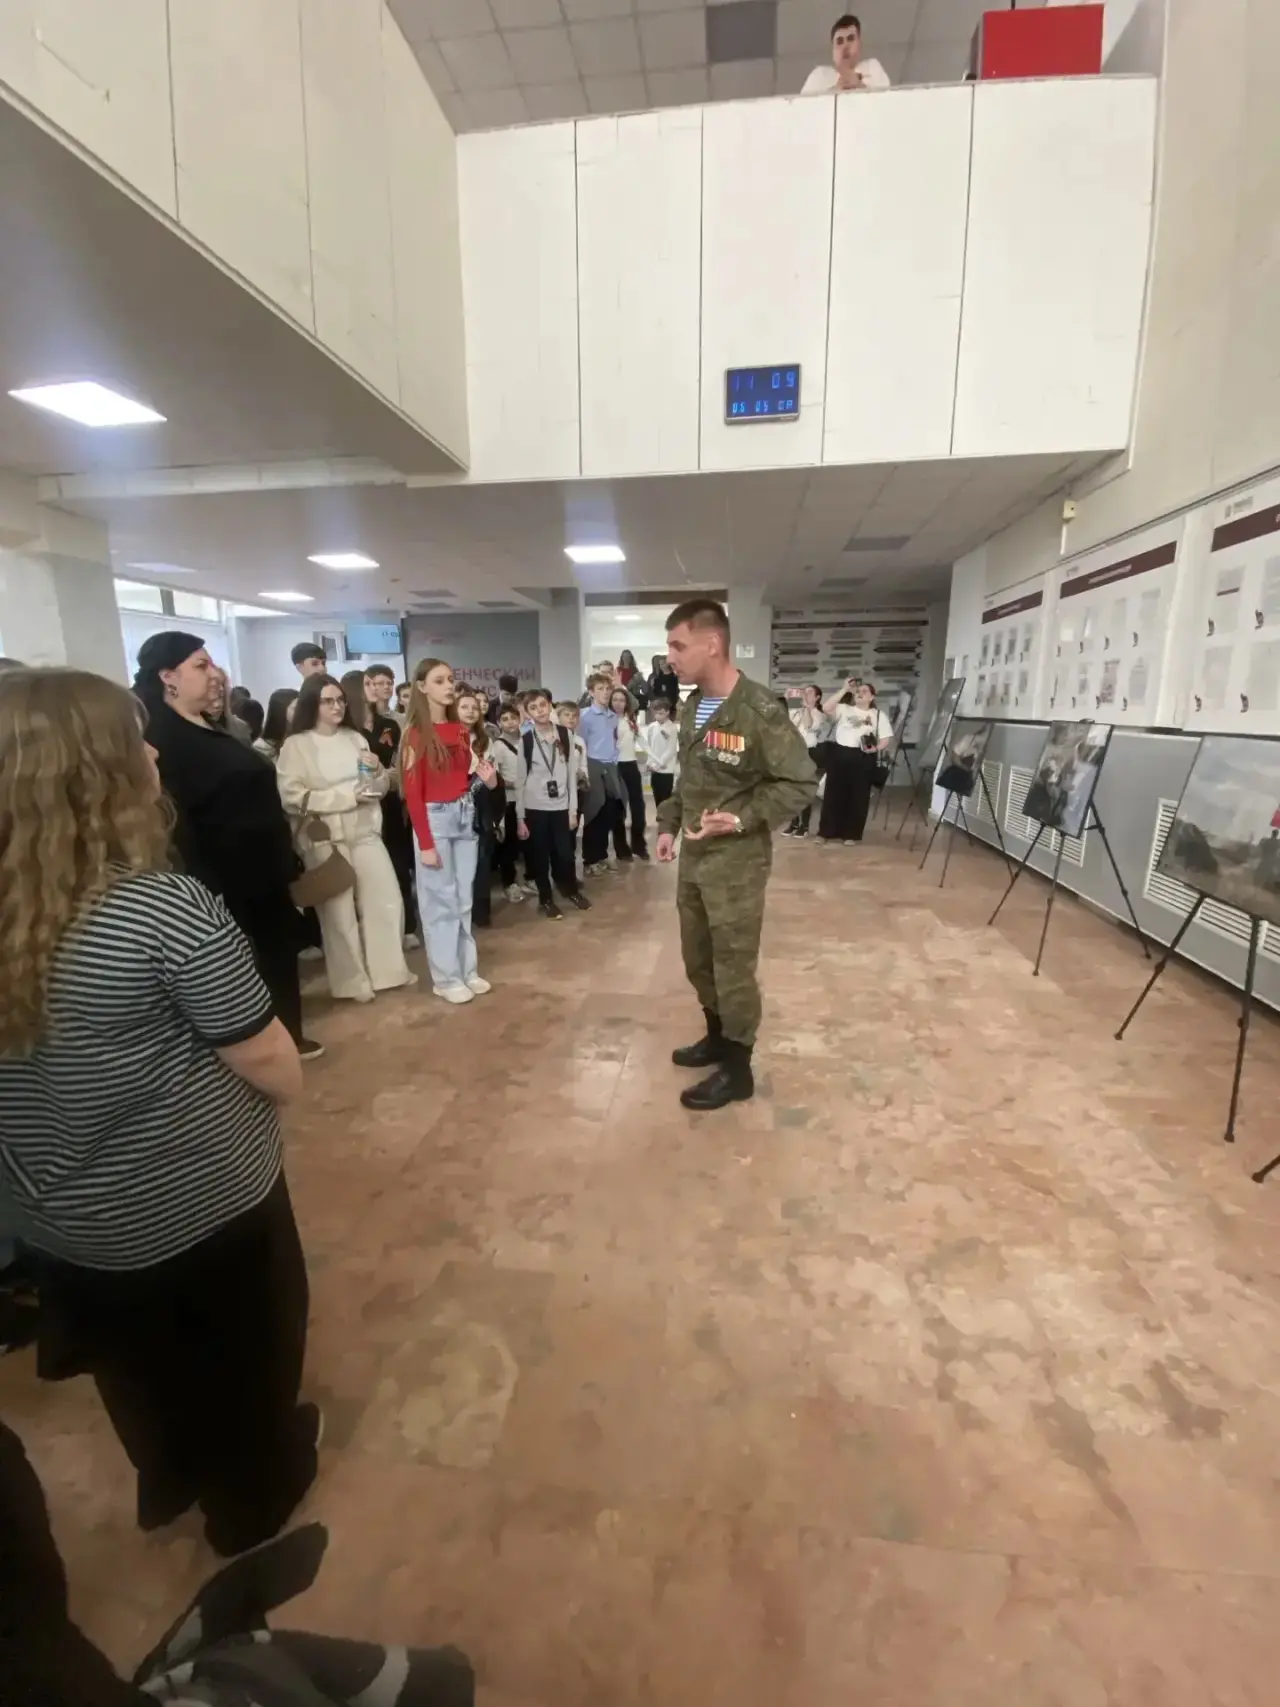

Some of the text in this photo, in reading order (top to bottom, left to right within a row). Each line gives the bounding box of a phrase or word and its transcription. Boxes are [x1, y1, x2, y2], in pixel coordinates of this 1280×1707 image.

[735, 371, 795, 391] 11 09
[453, 666, 536, 681] ЕНЧЕСКИЙ
